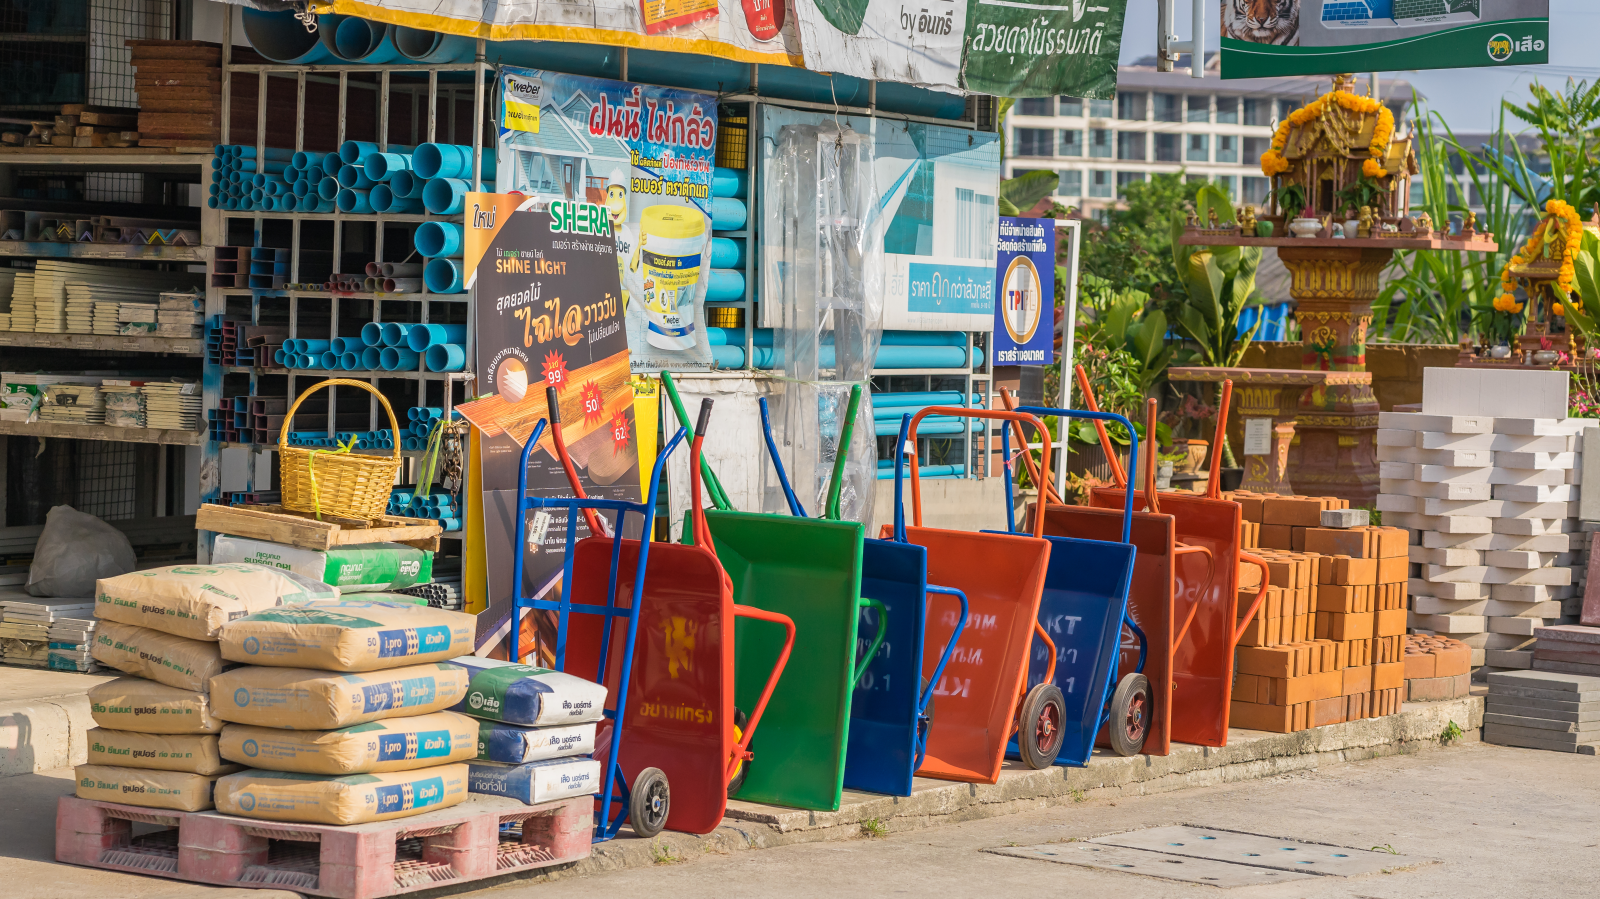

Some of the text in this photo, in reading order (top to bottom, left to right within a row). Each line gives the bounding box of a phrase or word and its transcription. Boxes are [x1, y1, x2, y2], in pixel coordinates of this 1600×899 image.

[901, 5, 953, 38] by อินทรี
[1515, 35, 1545, 52] เสือ
[513, 82, 541, 95] weber
[588, 86, 715, 150] ฝนนี้ ไม่กลัว
[630, 149, 640, 167] ใช้
[631, 175, 710, 203] เวเบอร์ ตราตุ๊กแก
[473, 203, 497, 230] ใหม่
[549, 200, 611, 238] SHERA
[615, 236, 631, 254] eber
[496, 259, 567, 275] SHINE LIGHT
[912, 271, 992, 305] ราคา ถูก กว่าสังกะสี
[496, 282, 542, 315] สุดยอดไม้
[514, 297, 585, 347] ไฉไล
[588, 320, 620, 345] ไม่เปลี่ยนแปลง
[998, 347, 1045, 361] เราสร้างอนาคต
[548, 370, 561, 384] 99
[585, 399, 598, 413] 50
[615, 427, 626, 441] 62
[142, 605, 165, 615] ซูเปอร์
[1046, 614, 1082, 635] KT
[367, 638, 377, 647] 50
[385, 637, 402, 651] i.pro
[140, 652, 163, 665] ซูเปอร์
[1028, 674, 1075, 693] N.1
[352, 694, 361, 703] 50
[370, 692, 388, 707] i.pro
[484, 696, 500, 708] เสือ
[562, 700, 572, 709] เสือ
[134, 706, 157, 716] ซูเปอร์
[367, 742, 377, 751] 50
[385, 741, 402, 755] i.pro
[133, 750, 156, 758] ซูเปอร์
[122, 785, 145, 793] ซูเปอร์
[475, 779, 507, 793] ก่อทั่วไป
[365, 794, 375, 804] 50
[382, 792, 399, 807] i.pro
